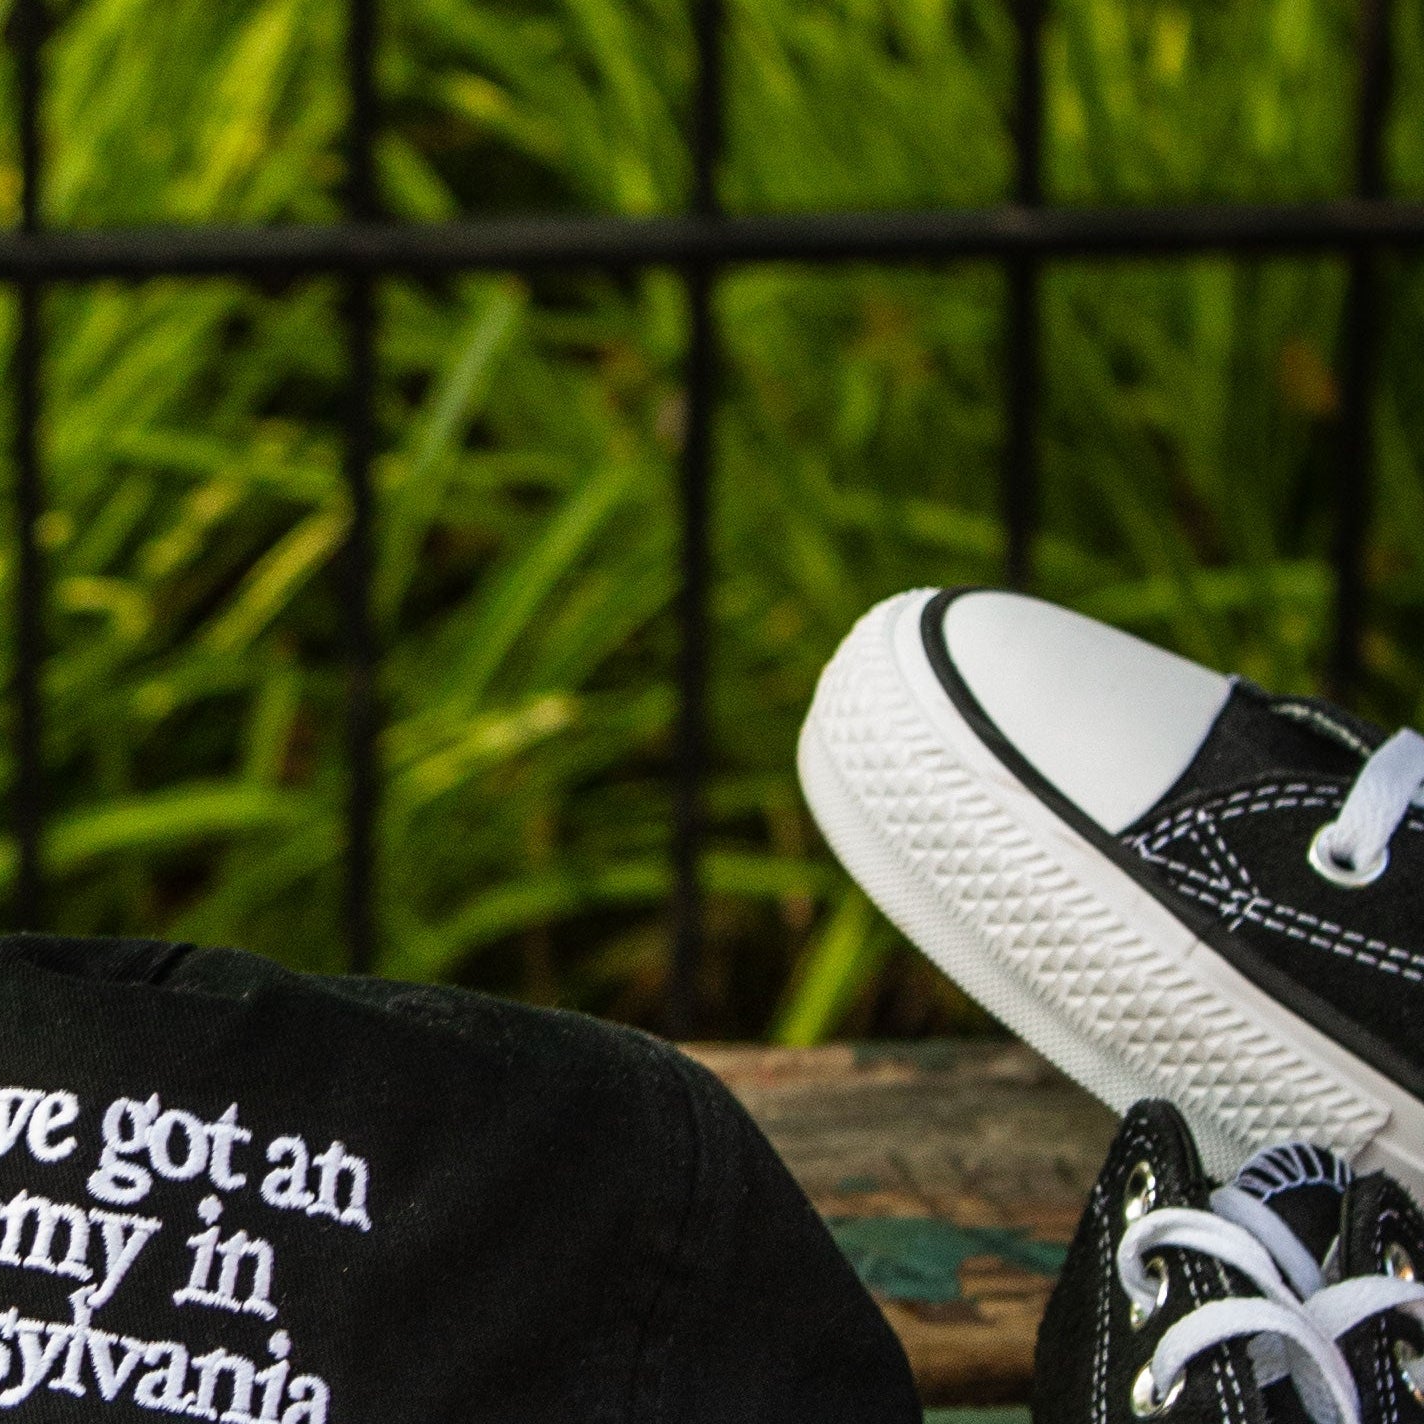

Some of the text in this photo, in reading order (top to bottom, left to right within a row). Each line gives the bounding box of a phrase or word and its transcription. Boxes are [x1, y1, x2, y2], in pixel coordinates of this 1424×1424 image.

[87, 1092, 252, 1206] got
[259, 1134, 372, 1232] an
[173, 1194, 278, 1321] in
